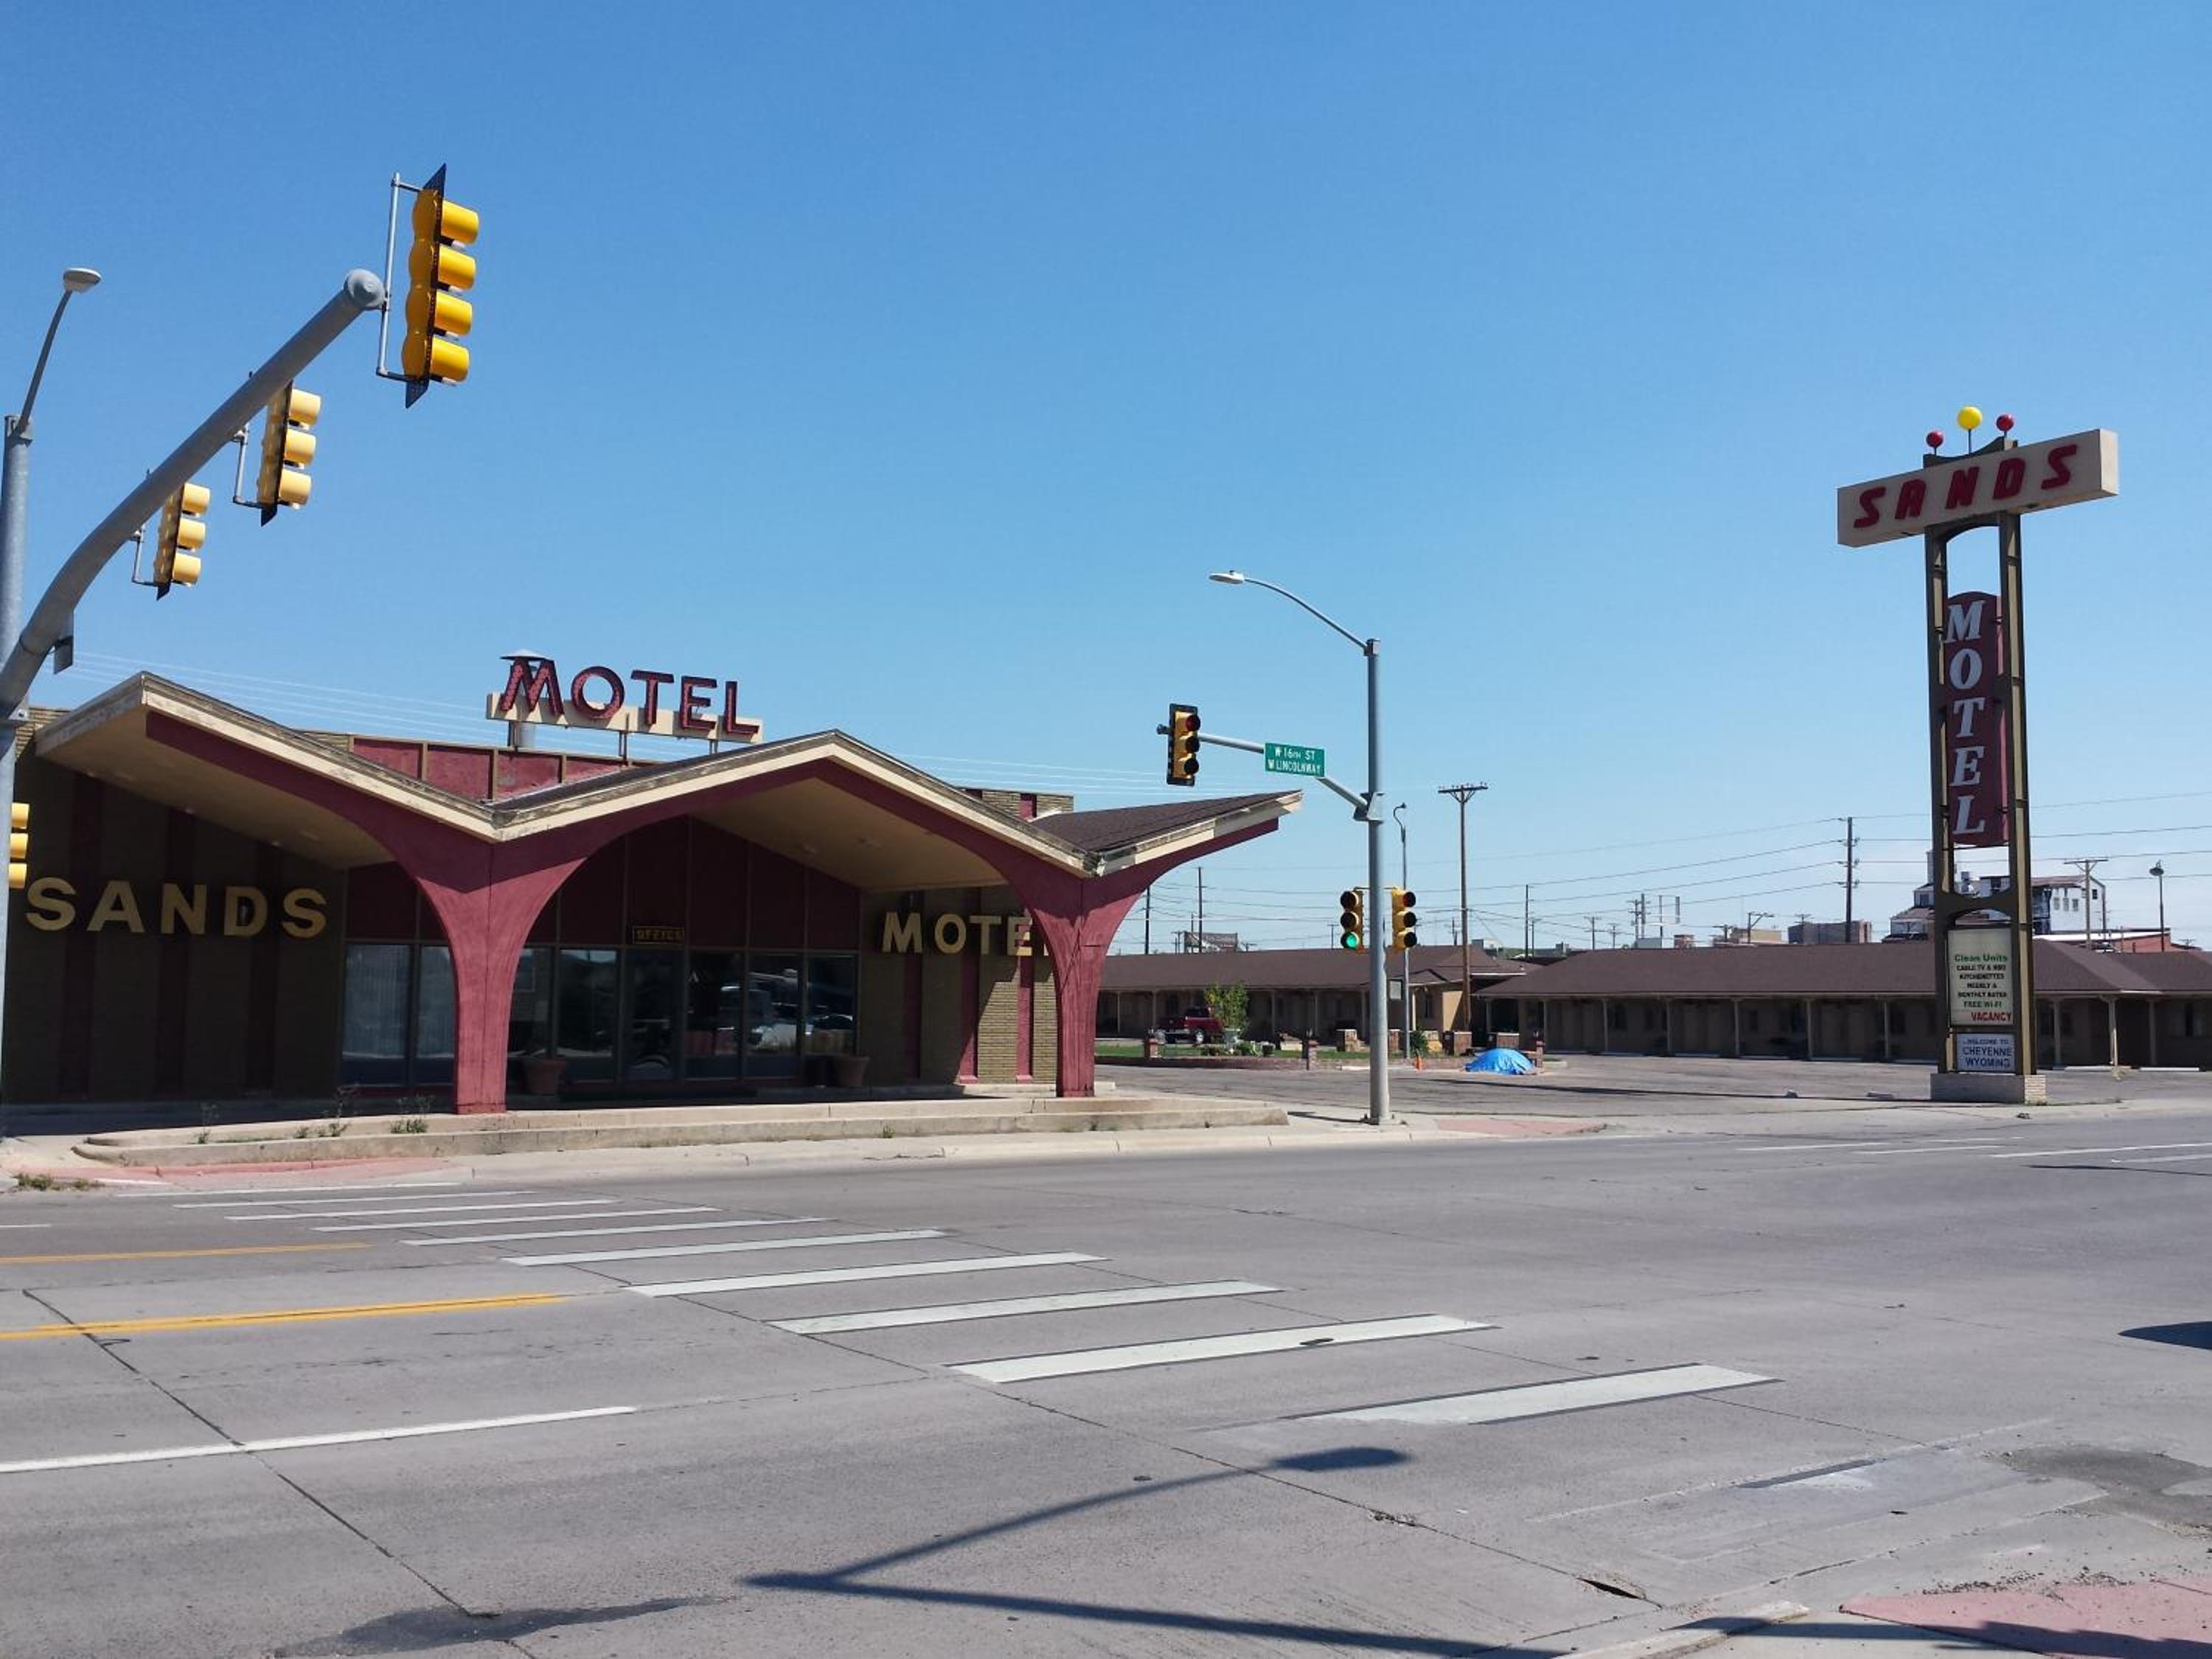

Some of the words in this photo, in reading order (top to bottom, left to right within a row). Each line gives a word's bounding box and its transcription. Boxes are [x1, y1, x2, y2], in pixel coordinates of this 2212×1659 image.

[1853, 444, 2078, 529] SANDS
[499, 658, 760, 735] MOTEL
[1943, 599, 1986, 835] MOTEL
[1275, 746, 1281, 757] W
[1304, 750, 1316, 761] ST
[1267, 759, 1275, 769] W
[24, 876, 327, 939] SANDS
[881, 911, 1049, 957] MOTE
[1954, 953, 1980, 962] Clean
[1983, 953, 2008, 962] Units
[1970, 1011, 2012, 1022] VACANCY
[1962, 1046, 2012, 1057] CHEYENNE
[1965, 1057, 2011, 1068] WYOMING
